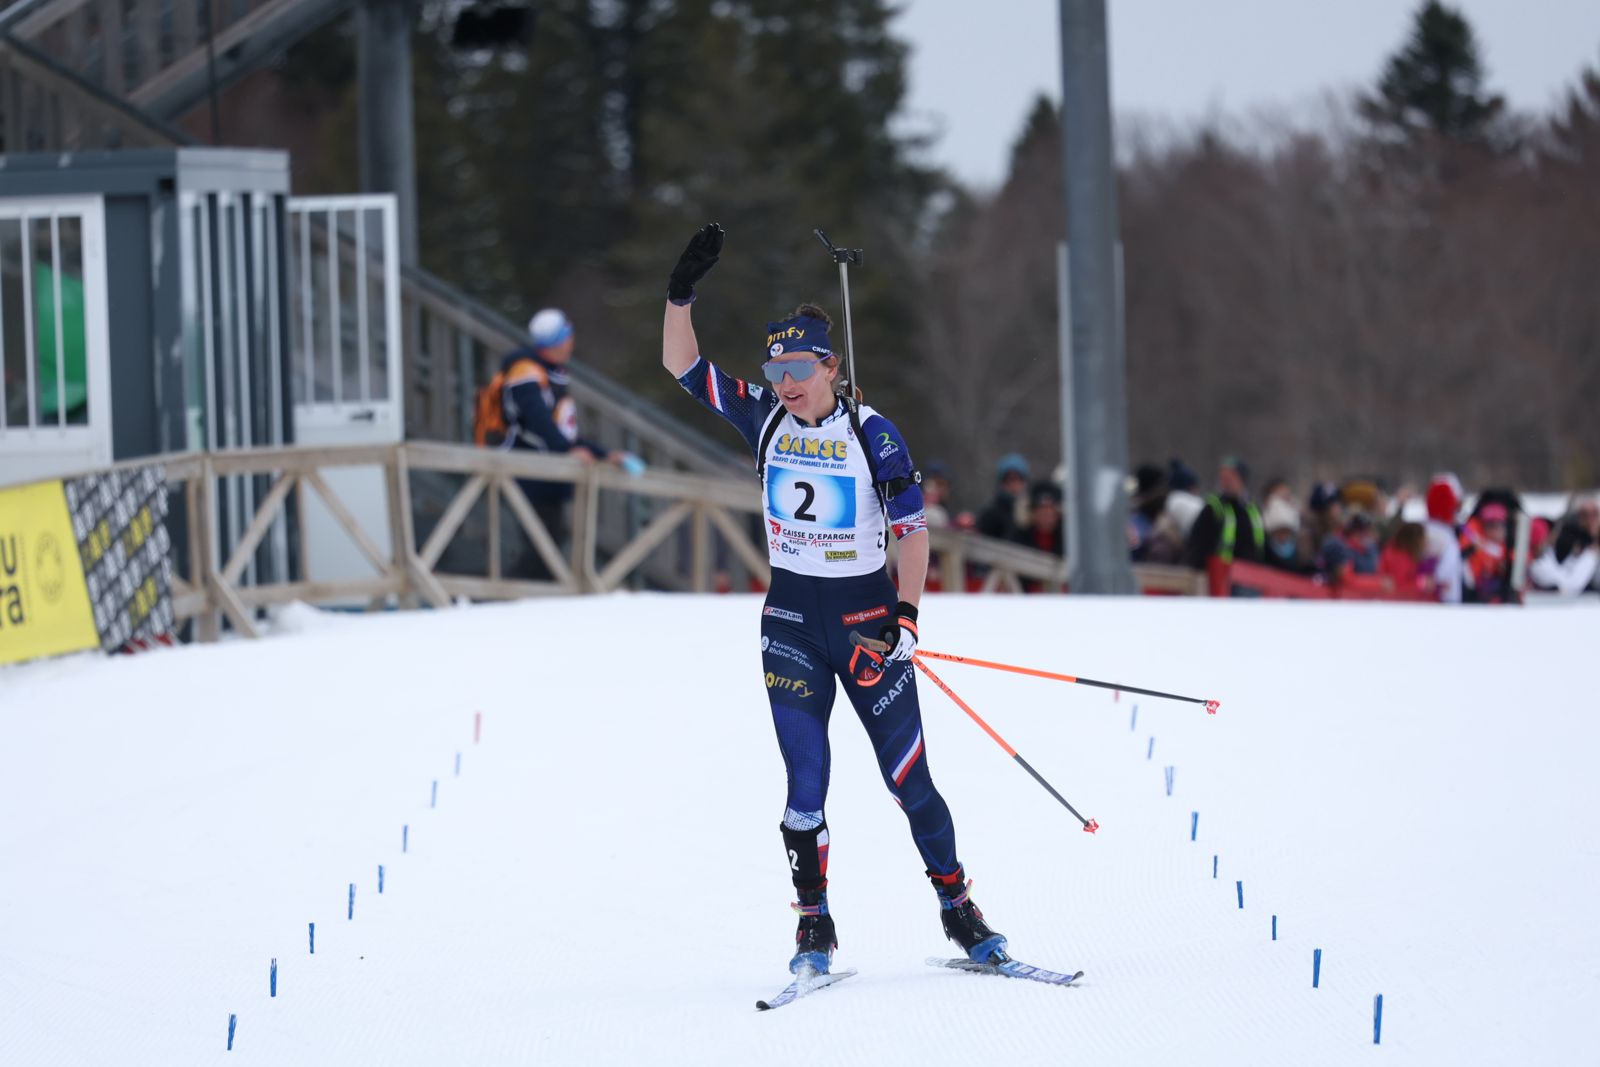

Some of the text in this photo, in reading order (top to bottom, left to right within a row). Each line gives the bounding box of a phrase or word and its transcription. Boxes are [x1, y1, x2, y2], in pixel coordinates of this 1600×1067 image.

[775, 433, 847, 462] SAMSE
[799, 459, 821, 468] HOMMES
[793, 481, 817, 522] 2
[782, 528, 856, 541] CAISSE D'EPARGNE
[845, 608, 886, 622] VIESSMANN
[768, 646, 814, 670] Rhône-Alpes
[771, 640, 809, 660] Auvergne-
[872, 672, 910, 716] CRAFT
[788, 849, 799, 871] 2
